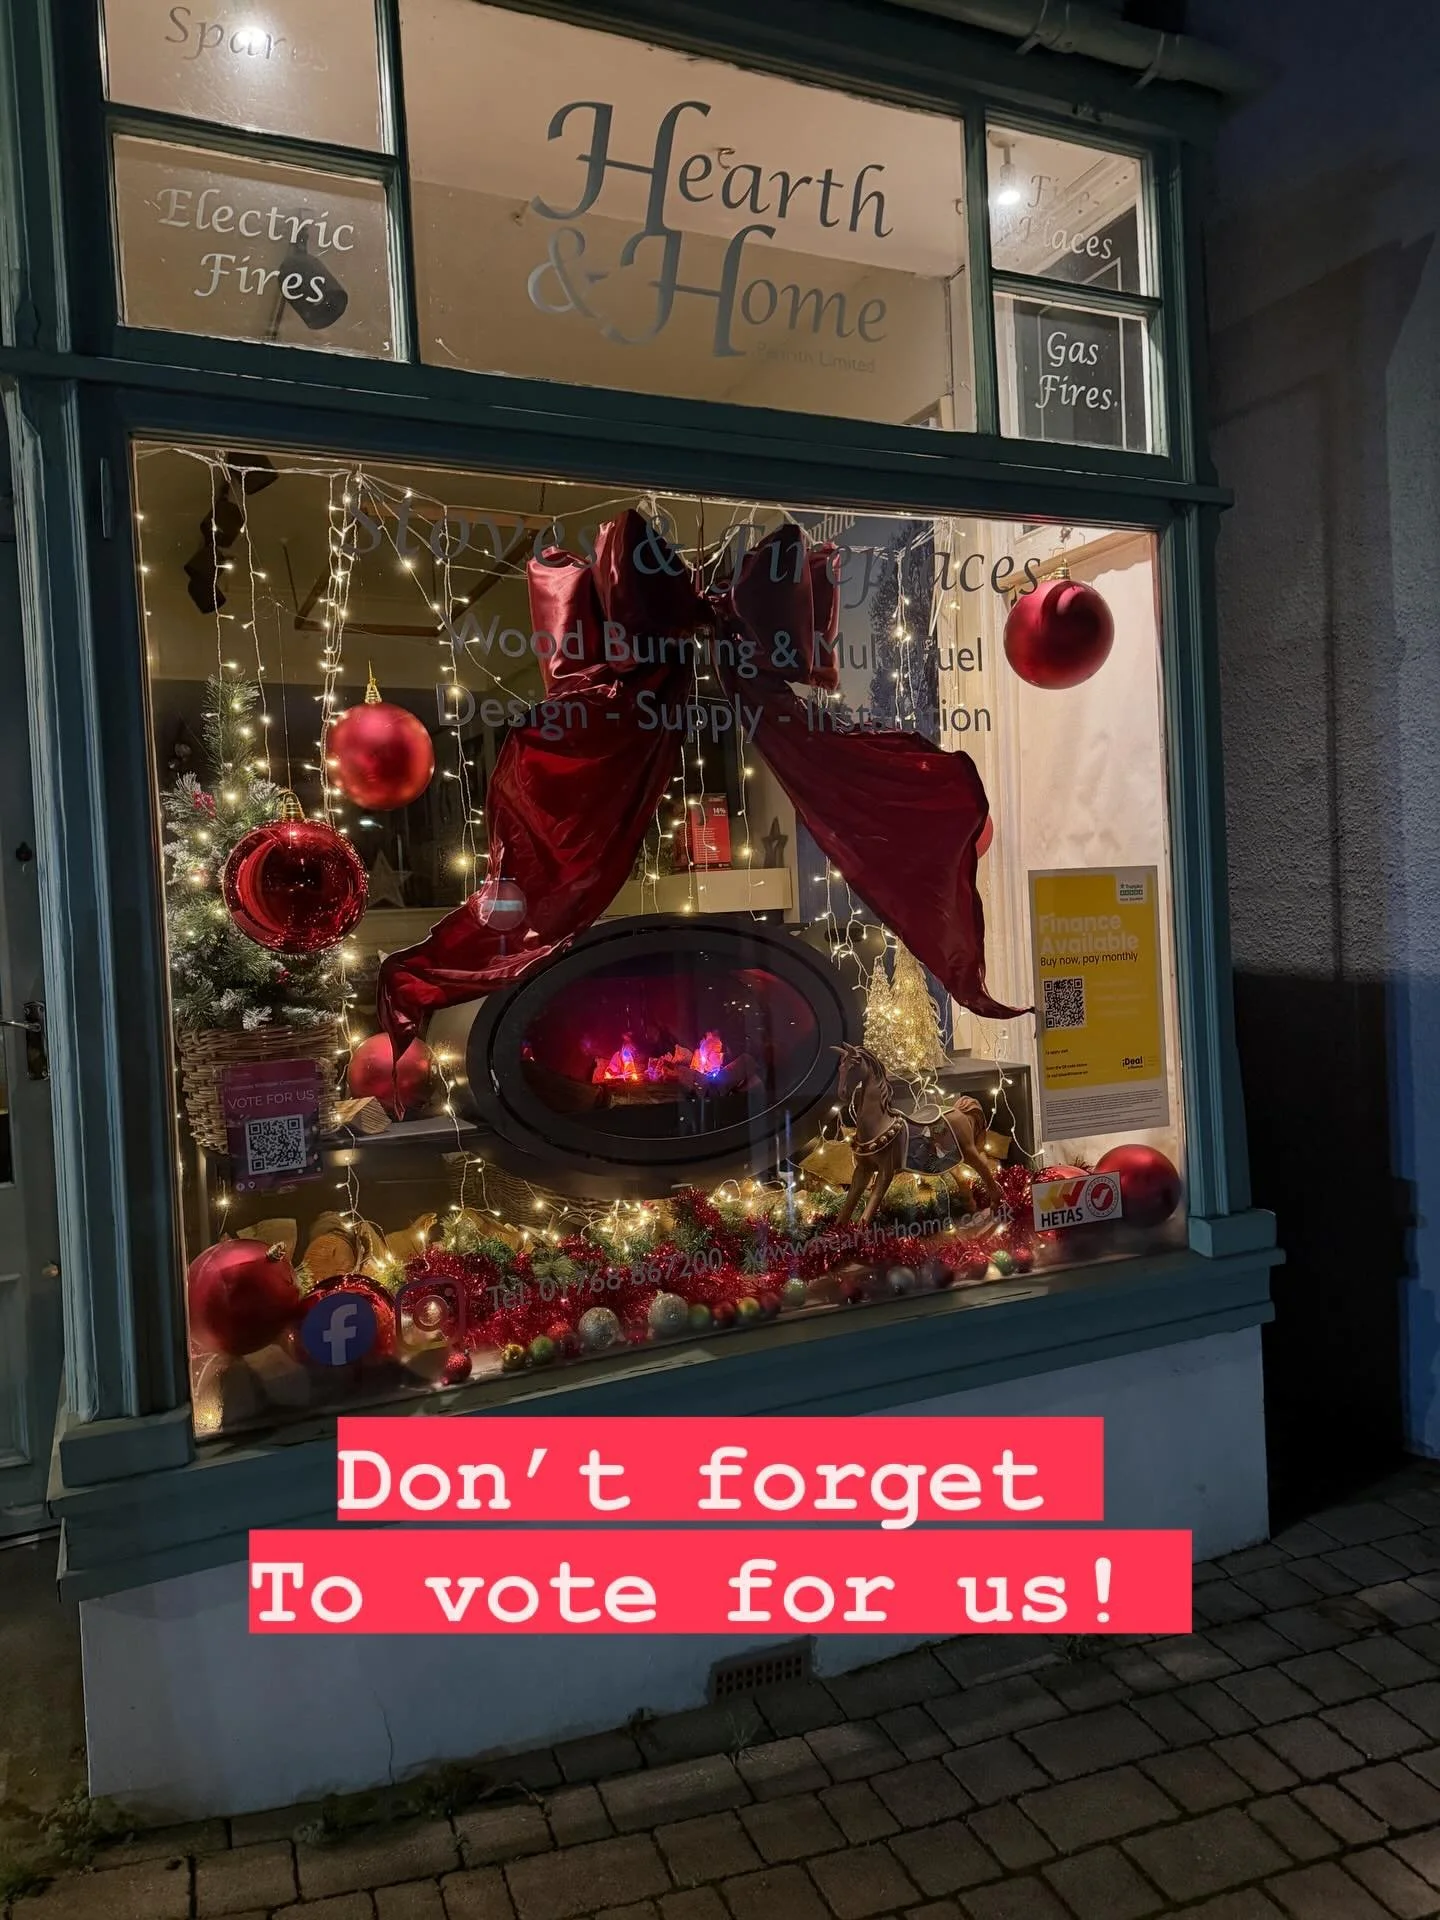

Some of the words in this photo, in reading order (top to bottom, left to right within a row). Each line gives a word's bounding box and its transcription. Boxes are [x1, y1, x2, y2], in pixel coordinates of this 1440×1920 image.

[530, 100, 894, 239] Hearth
[157, 188, 355, 251] Electric
[193, 252, 327, 304] Fires
[603, 223, 888, 358] Home
[1046, 331, 1099, 367] Gas
[342, 484, 597, 569] Stoves
[632, 515, 686, 577] &
[447, 612, 584, 661] Wood
[603, 620, 757, 680] Burning
[770, 630, 801, 668] &
[435, 682, 588, 741] Design
[637, 690, 765, 745] Supply
[1038, 911, 1122, 934] Finance
[1040, 931, 1140, 953] Available
[1039, 956, 1057, 967] Buy
[1059, 954, 1081, 965] now,
[1082, 954, 1100, 966] pay
[1101, 951, 1139, 963] monthly
[227, 1095, 263, 1110] VOTE
[266, 1092, 293, 1106] FOR
[295, 1089, 316, 1102] US
[1040, 1207, 1085, 1228] HETAS
[539, 1267, 622, 1302] 01768
[630, 1247, 723, 1287] 867200
